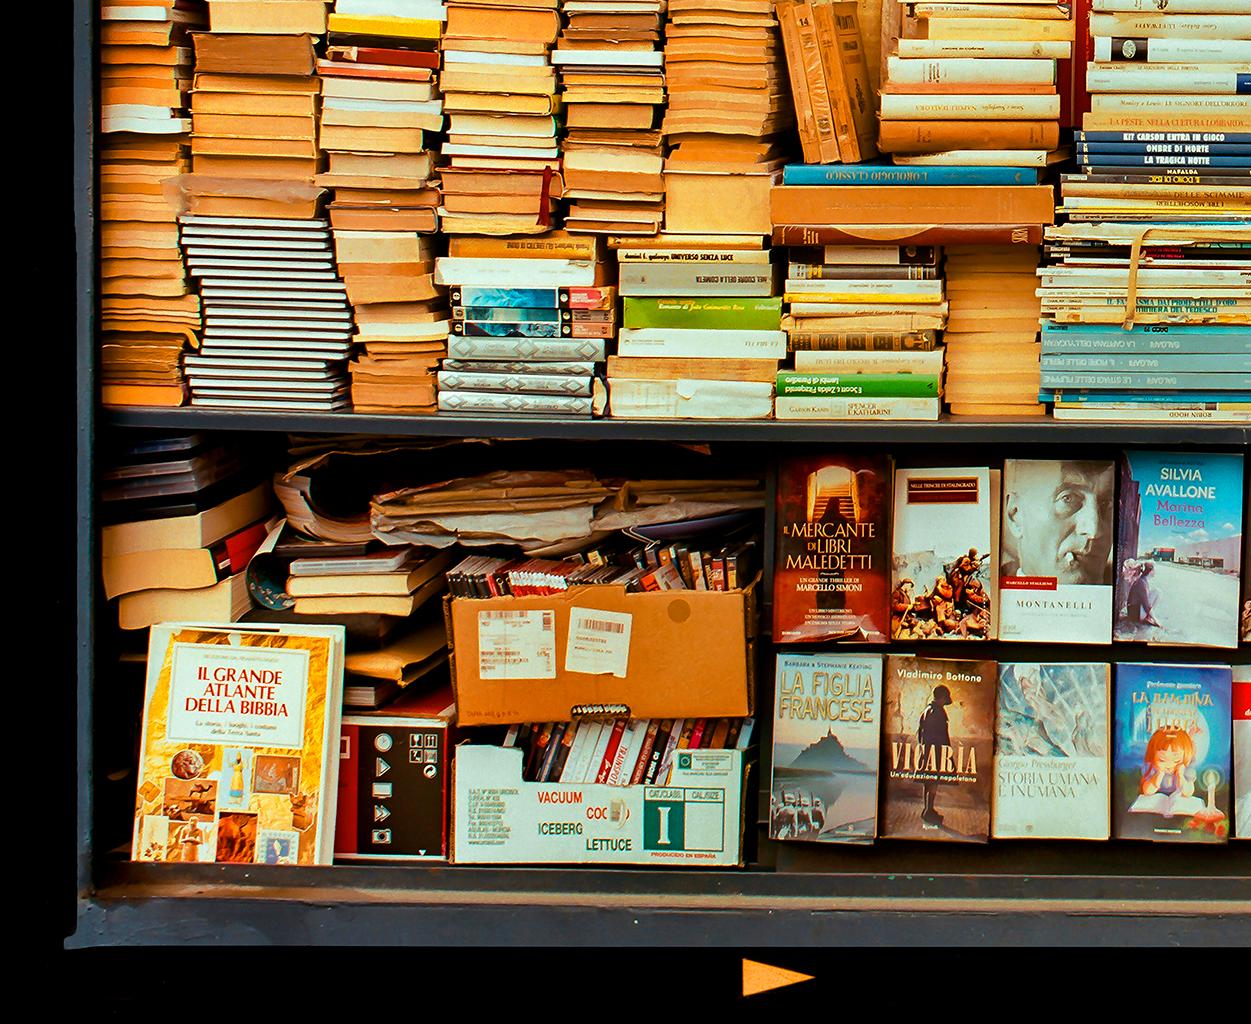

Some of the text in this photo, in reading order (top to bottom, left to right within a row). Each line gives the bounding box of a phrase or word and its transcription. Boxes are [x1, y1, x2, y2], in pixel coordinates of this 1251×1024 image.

[1123, 133, 1225, 141] KIT CARSON ENTRA IN GIOCO
[1146, 144, 1209, 153] OMBRE DI MORTE
[1144, 156, 1210, 165] LA TRAGICA NOTTE
[826, 171, 869, 180] CLASSICO
[1160, 467, 1202, 481] SILVIA
[1145, 483, 1216, 499] AVALLONE
[1156, 499, 1203, 514] Marina
[1153, 514, 1205, 528] Bellezza
[791, 522, 876, 538] MERCANTE
[807, 539, 851, 554] DI LIBRI
[785, 554, 872, 570] MALEDETTI
[796, 583, 862, 592] MARCELLO SIMONI
[1016, 600, 1093, 610] MONTANELLI
[198, 666, 283, 685] IL GRANDE
[896, 668, 982, 683] Vladimiro Bottone
[203, 683, 276, 700] ATLANTE
[780, 671, 875, 698] LA FIGLIA
[185, 697, 289, 717] DELLA BIBBIA
[778, 695, 874, 723] FRANCESE
[891, 741, 977, 775] VICARÌA
[939, 773, 977, 783] napoletana
[998, 772, 1099, 786] STORIA UMANA
[537, 791, 583, 804] VACUUM
[1008, 785, 1077, 799] INUMANA
[537, 823, 583, 836] ICEBERG
[586, 838, 632, 851] LETTUCE
